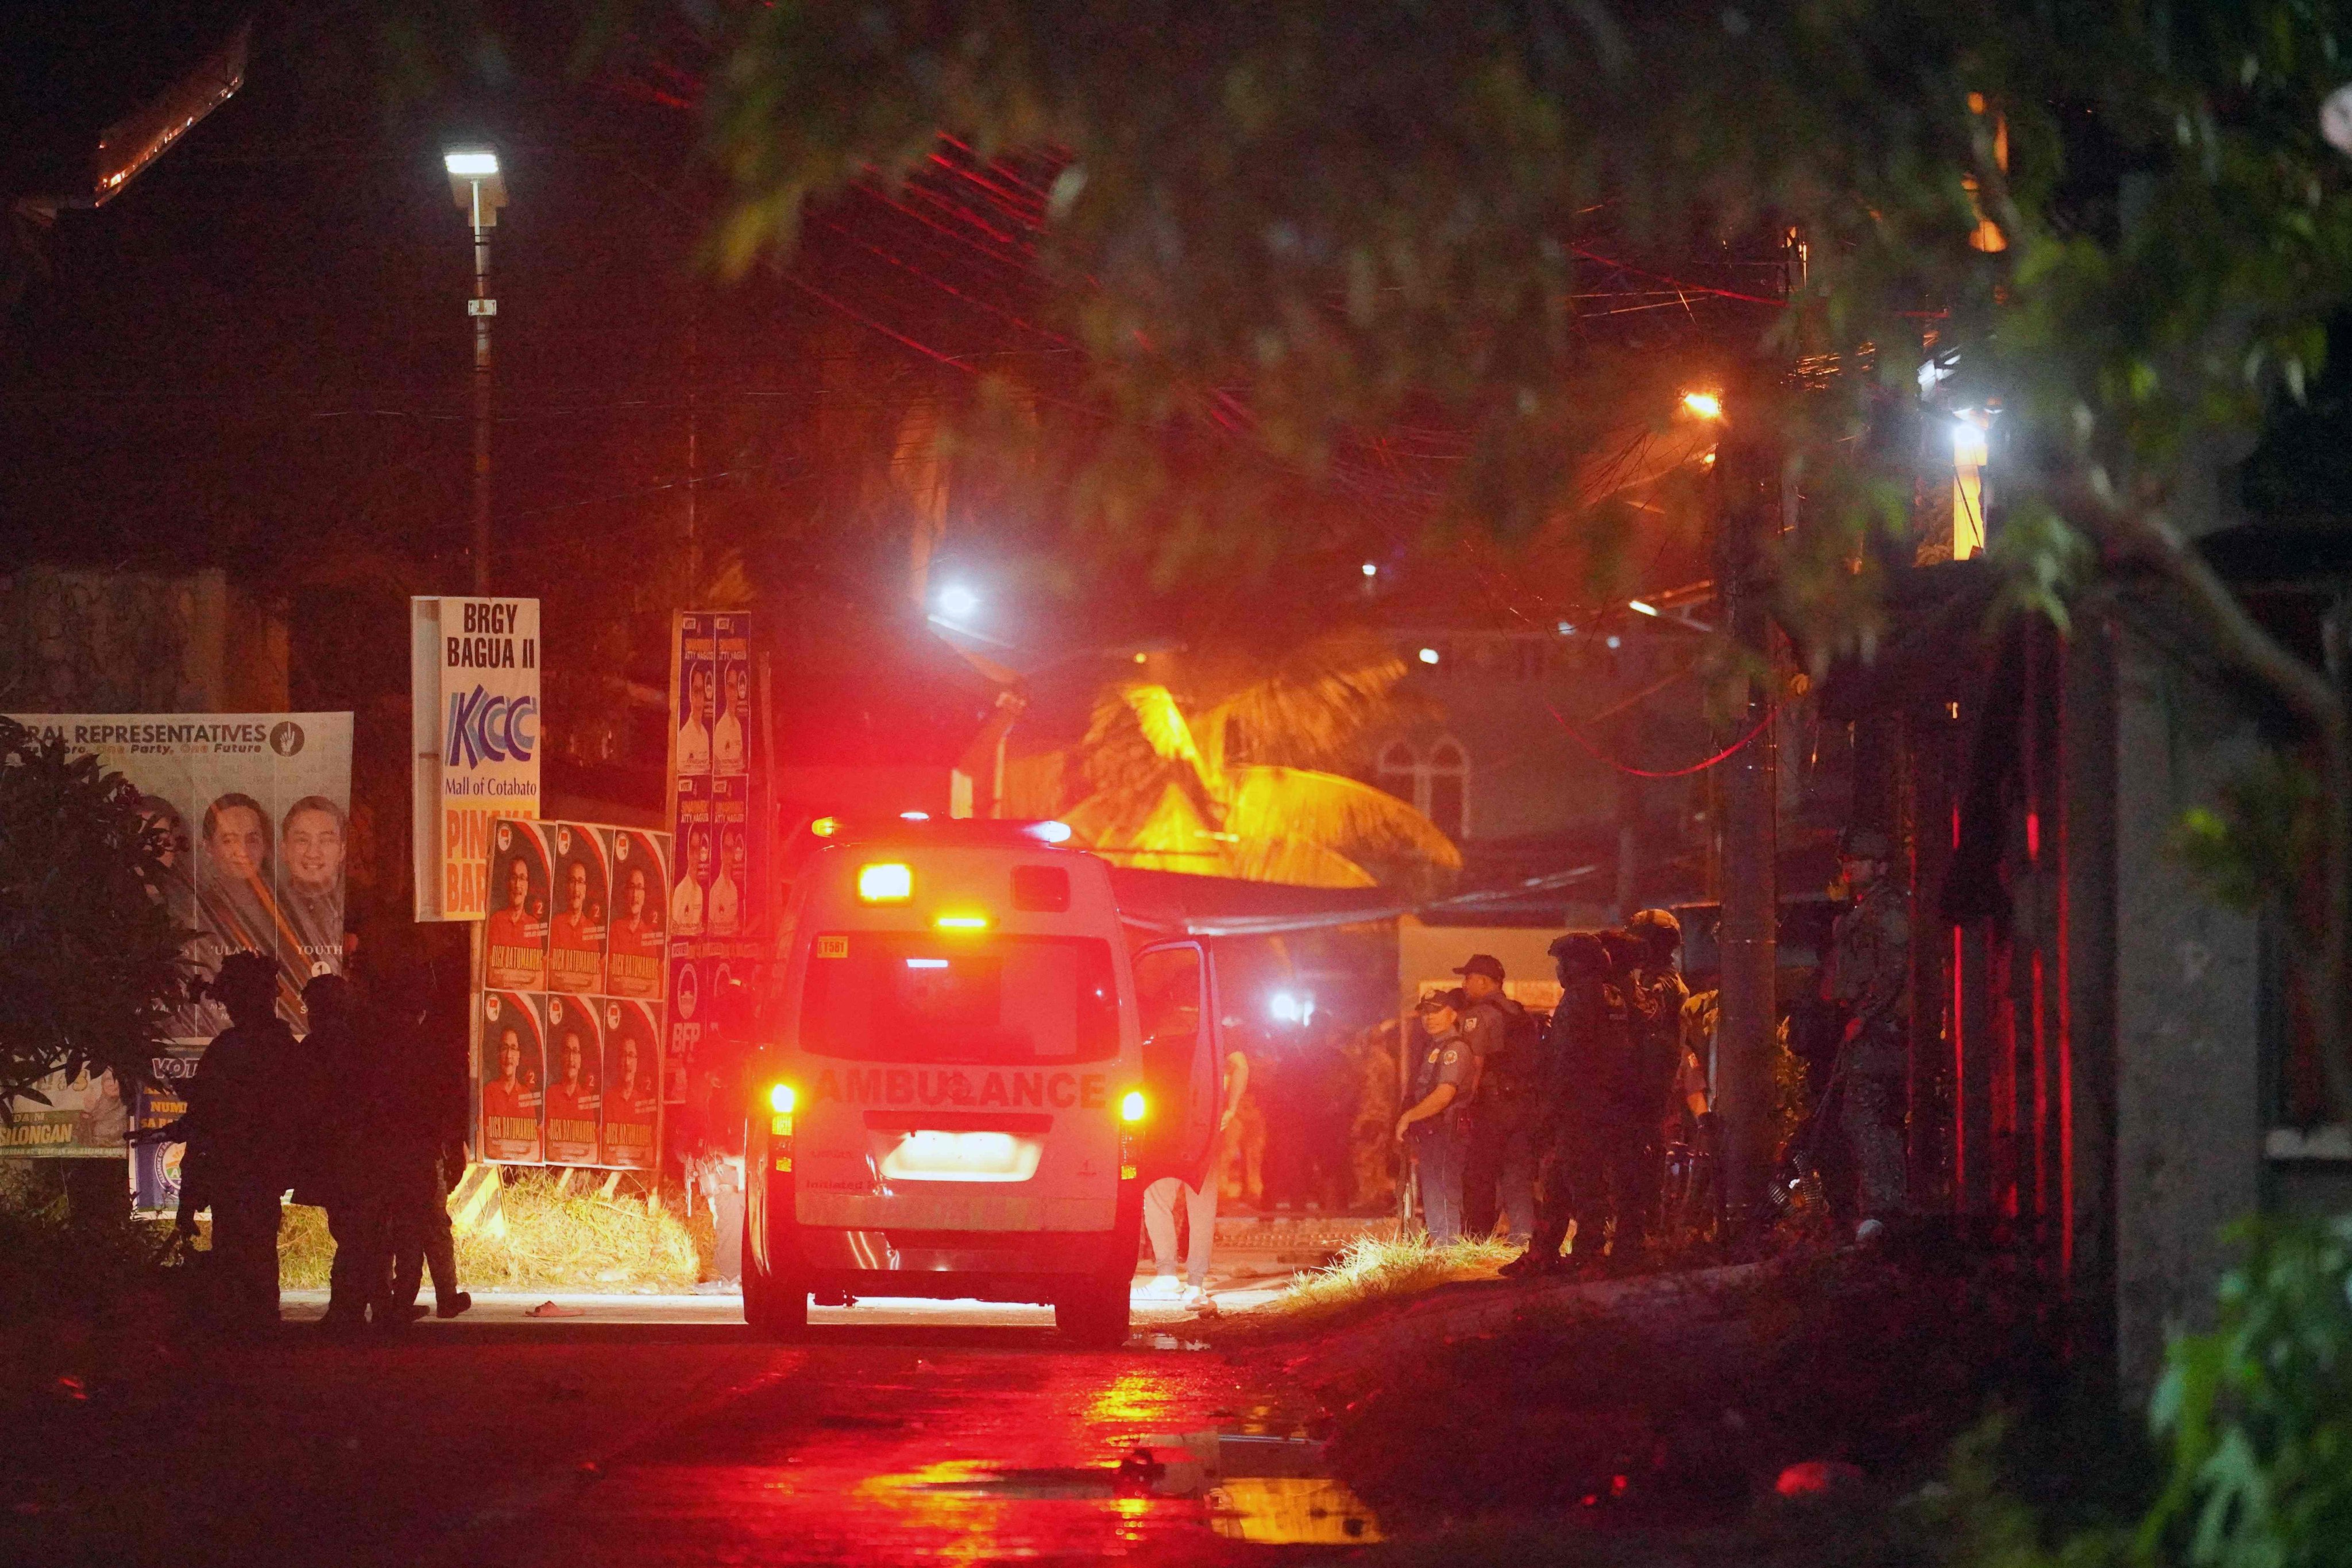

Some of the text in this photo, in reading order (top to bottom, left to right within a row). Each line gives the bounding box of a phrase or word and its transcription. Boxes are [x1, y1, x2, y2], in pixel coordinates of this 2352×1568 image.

[464, 603, 518, 635] BRGY
[447, 637, 535, 669] BAGUA II
[75, 724, 267, 744] REPRESENTATIVES
[446, 683, 537, 770] KCC
[130, 744, 174, 755] Party,
[214, 744, 262, 754] Future
[445, 777, 537, 796] Mall of Cotabato
[536, 902, 543, 914] 2
[594, 905, 600, 917] 2
[651, 912, 658, 924] 2
[297, 945, 343, 955] YOUTH
[491, 945, 505, 968] DICK
[553, 948, 565, 970] DICK
[612, 953, 624, 975] DICK
[152, 1057, 200, 1079] VOT
[529, 1072, 535, 1084] 2
[589, 1075, 594, 1087] 2
[813, 1067, 1107, 1109] AMBULANCE
[488, 1115, 501, 1138] DICK
[550, 1118, 562, 1140] DICK
